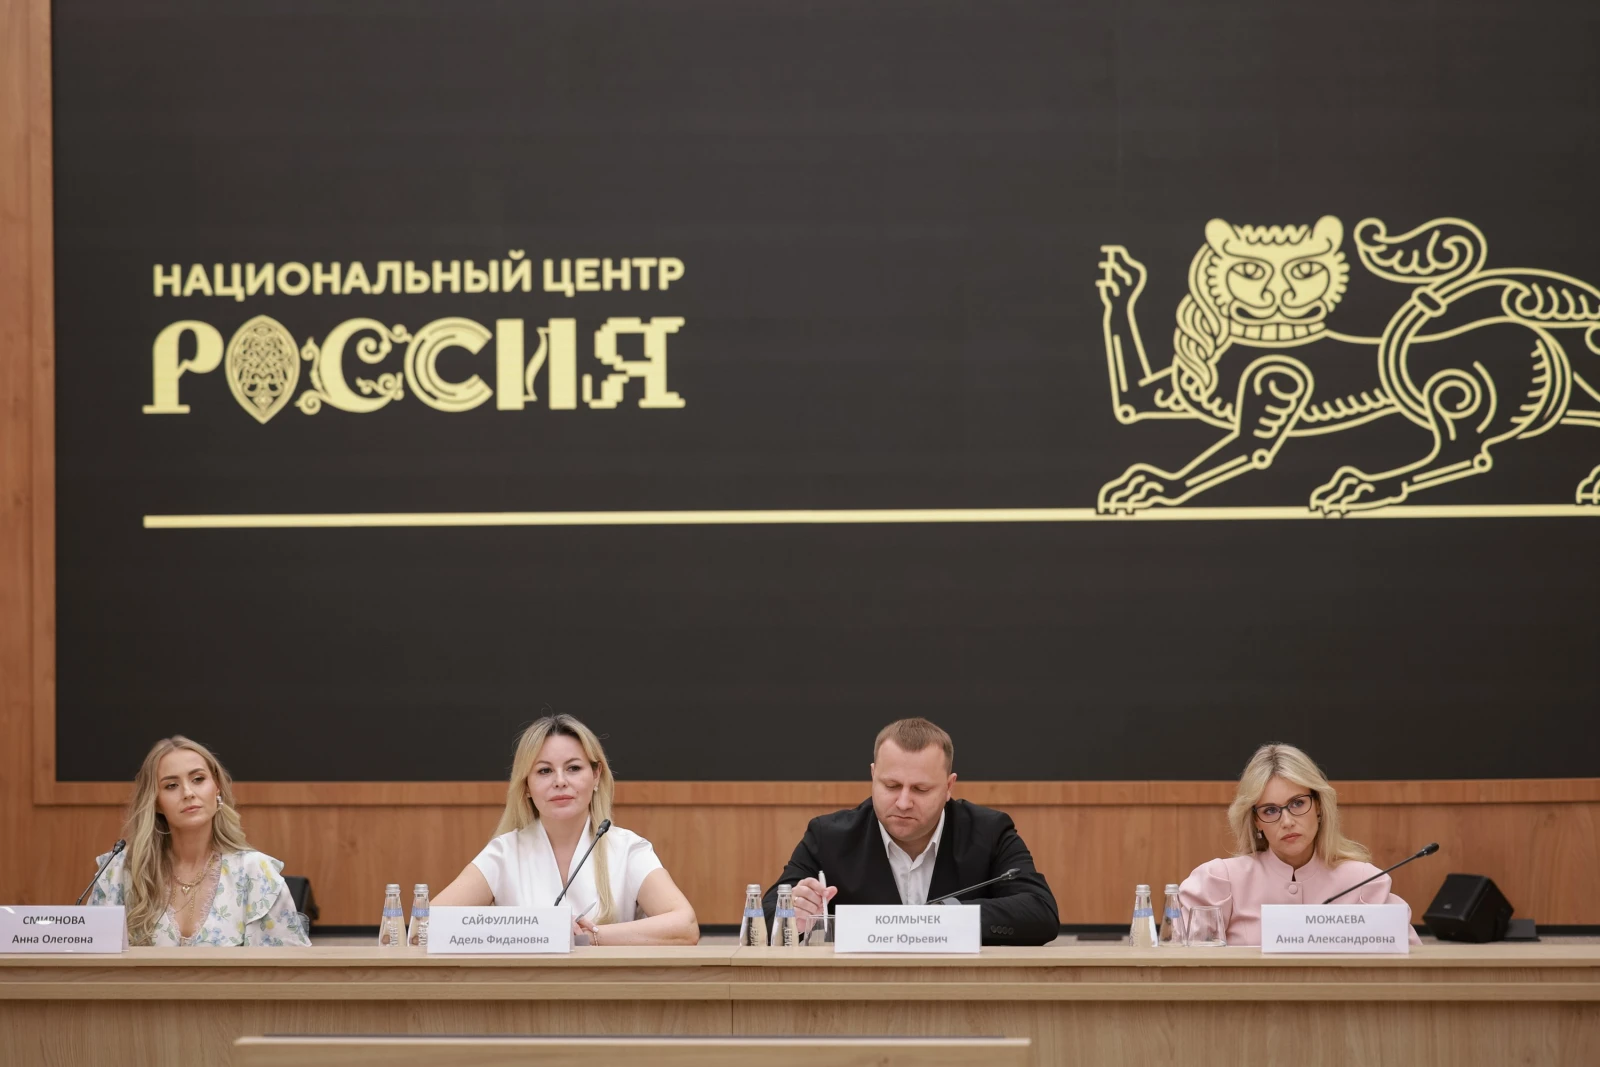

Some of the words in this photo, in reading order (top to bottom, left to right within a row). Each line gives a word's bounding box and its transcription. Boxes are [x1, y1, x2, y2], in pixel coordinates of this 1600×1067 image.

[154, 250, 531, 301] НАЦИОНАЛЬНЫЙ
[544, 258, 684, 297] ЦЕНТР
[143, 315, 685, 424] РОССИЯ
[461, 914, 539, 926] САЙФУЛЛИНА
[875, 915, 941, 925] КОЛМЫЧЕК
[1305, 914, 1366, 925] МОЖАЕВА
[11, 934, 39, 944] Анна
[41, 934, 94, 944] Олеговна
[449, 935, 484, 947] Адель
[486, 934, 550, 946] Фидановна
[867, 933, 894, 944] Олег
[896, 933, 948, 946] Юрьевич
[1275, 934, 1305, 944] Анна
[1307, 934, 1396, 946] Александровна
